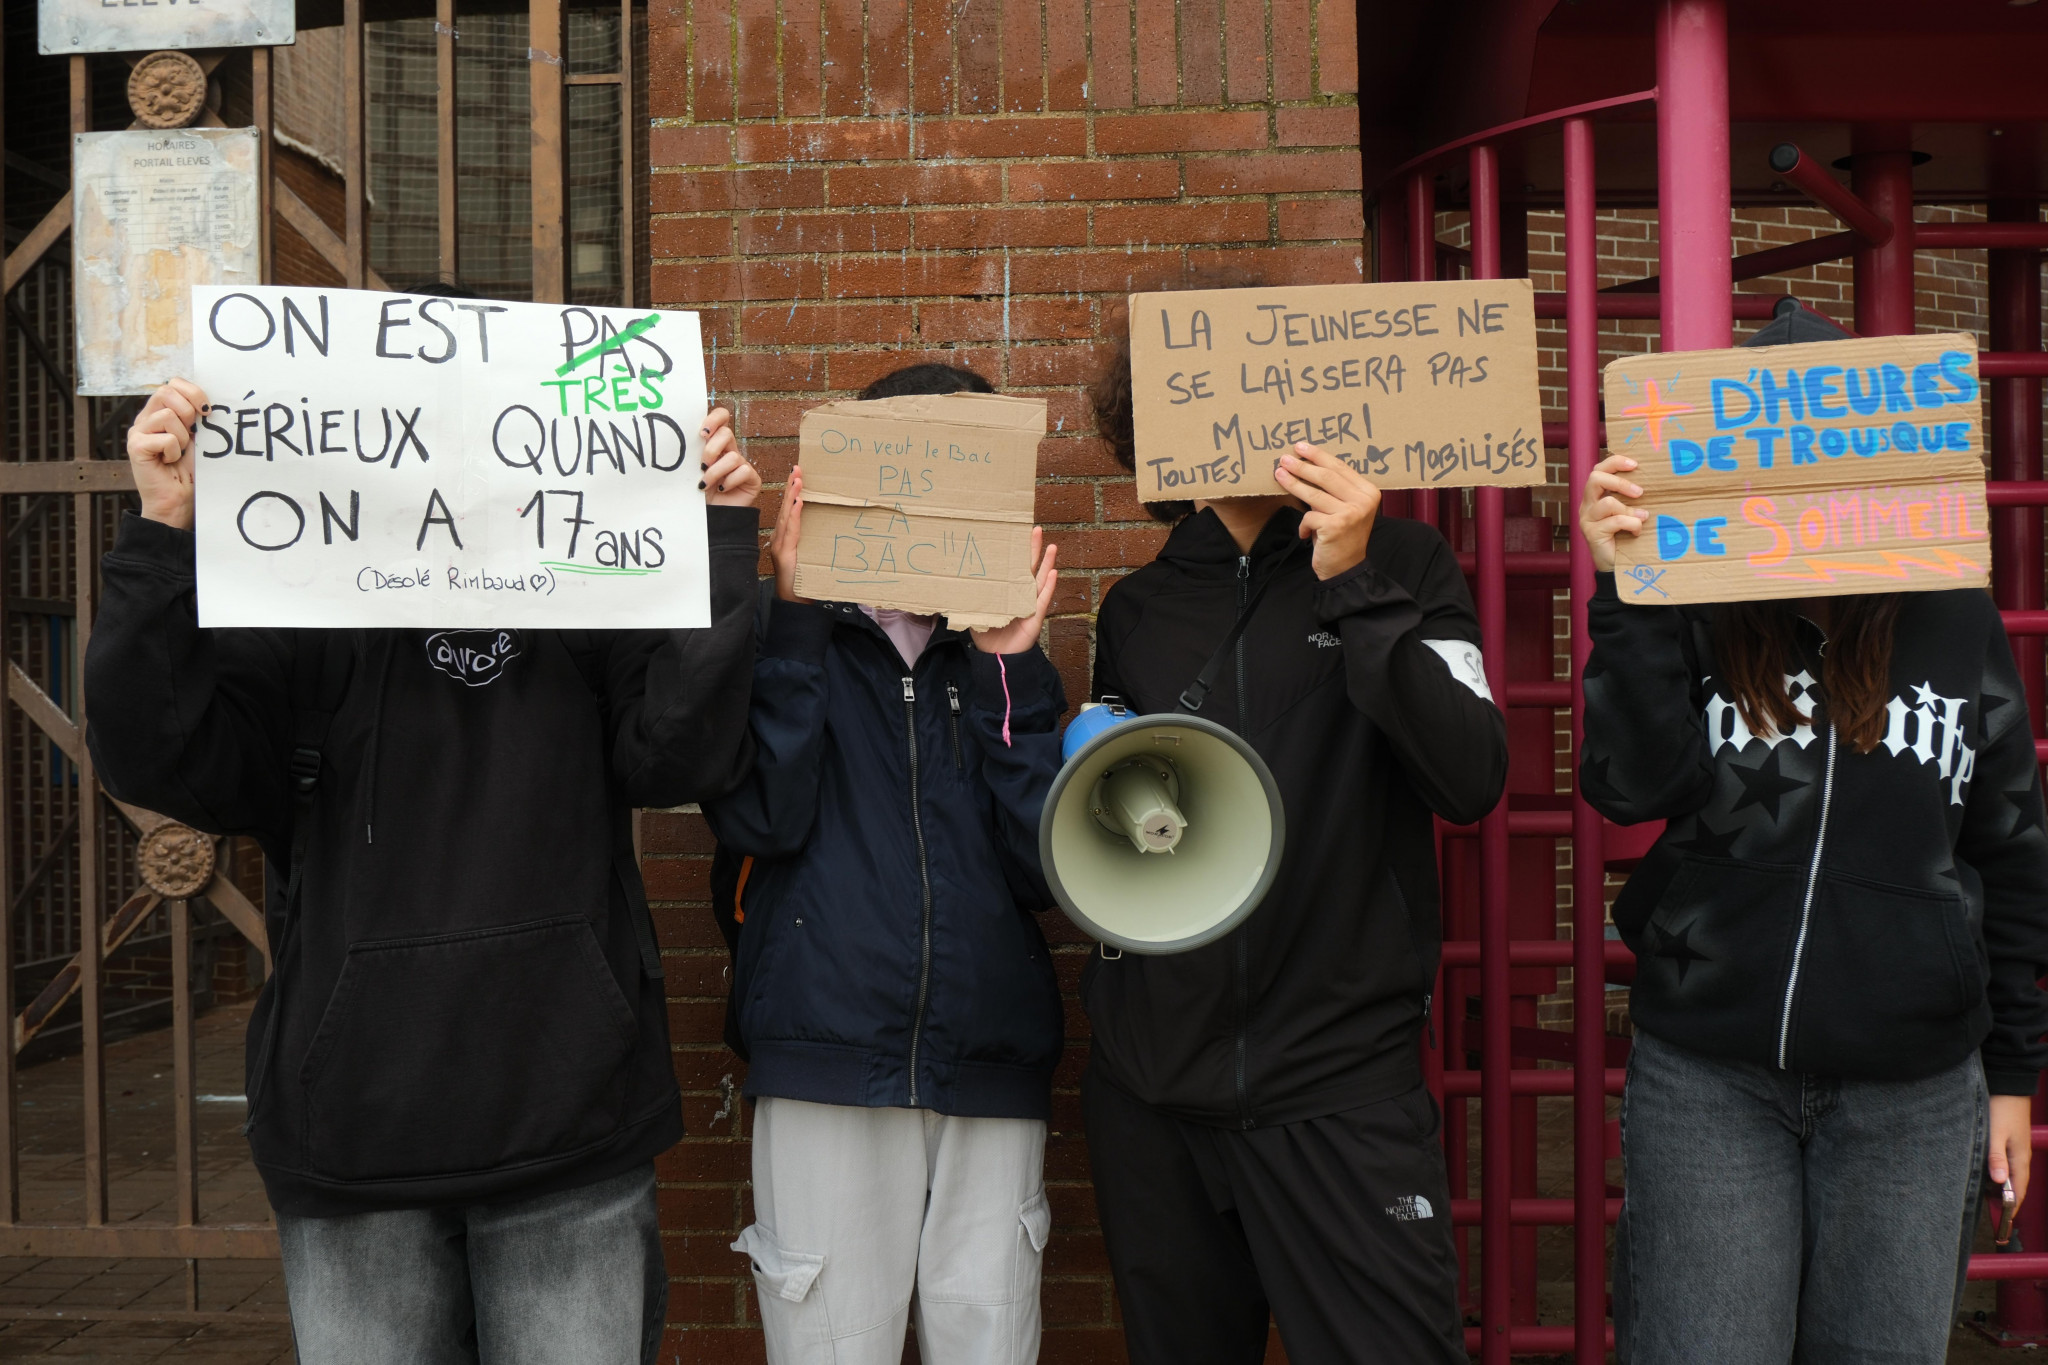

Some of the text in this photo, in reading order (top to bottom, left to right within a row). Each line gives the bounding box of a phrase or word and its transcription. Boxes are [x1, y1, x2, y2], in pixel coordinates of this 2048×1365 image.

[134, 156, 210, 168] PORTAIL ELEVES
[147, 140, 196, 151] HORAIRES
[208, 292, 674, 379] ON EST PAS
[1161, 298, 1510, 351] LA JEUNESSE NE
[540, 364, 666, 417] TRÈS
[1166, 369, 1215, 405] SE
[1427, 351, 1490, 388] PAS
[1710, 350, 1980, 432] D'HEURES
[492, 404, 687, 476] QUAND
[821, 429, 992, 465] On veut le Bac
[1668, 434, 1739, 476] DE
[878, 465, 934, 494] PAS
[236, 490, 360, 552] ON
[416, 488, 463, 552] A
[520, 489, 594, 559] 17
[854, 498, 911, 534] LA
[1656, 514, 1728, 562] DE
[357, 566, 430, 592] (Désolé
[1317, 637, 1342, 648] FACE
[1385, 1203, 1417, 1216] NORTH
[1396, 1211, 1418, 1221] FACE
[1397, 1196, 1415, 1205] THE
